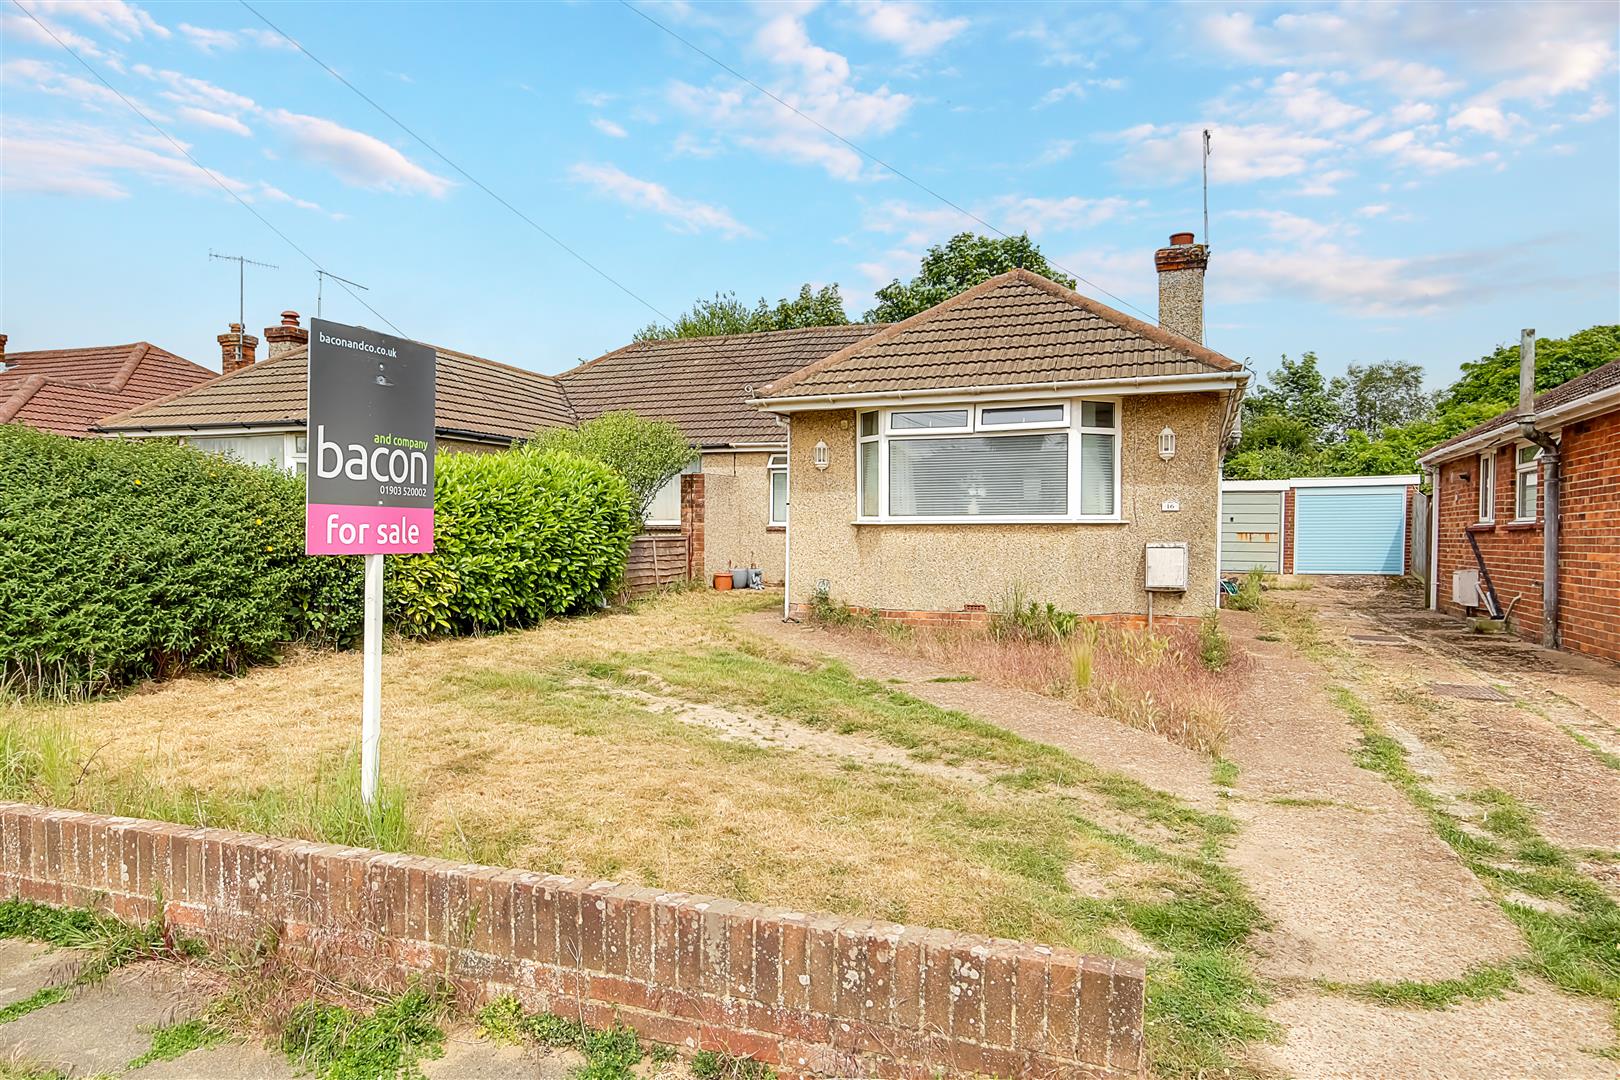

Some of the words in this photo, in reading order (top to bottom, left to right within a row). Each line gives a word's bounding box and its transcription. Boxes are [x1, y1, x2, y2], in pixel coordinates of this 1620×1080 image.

[319, 331, 397, 358] baconandco.co.uk
[317, 424, 428, 485] bacon
[374, 433, 392, 445] and
[393, 436, 428, 452] company
[379, 485, 402, 496] 01903
[402, 487, 427, 497] 520002
[326, 513, 370, 545] for
[376, 516, 420, 545] sale
